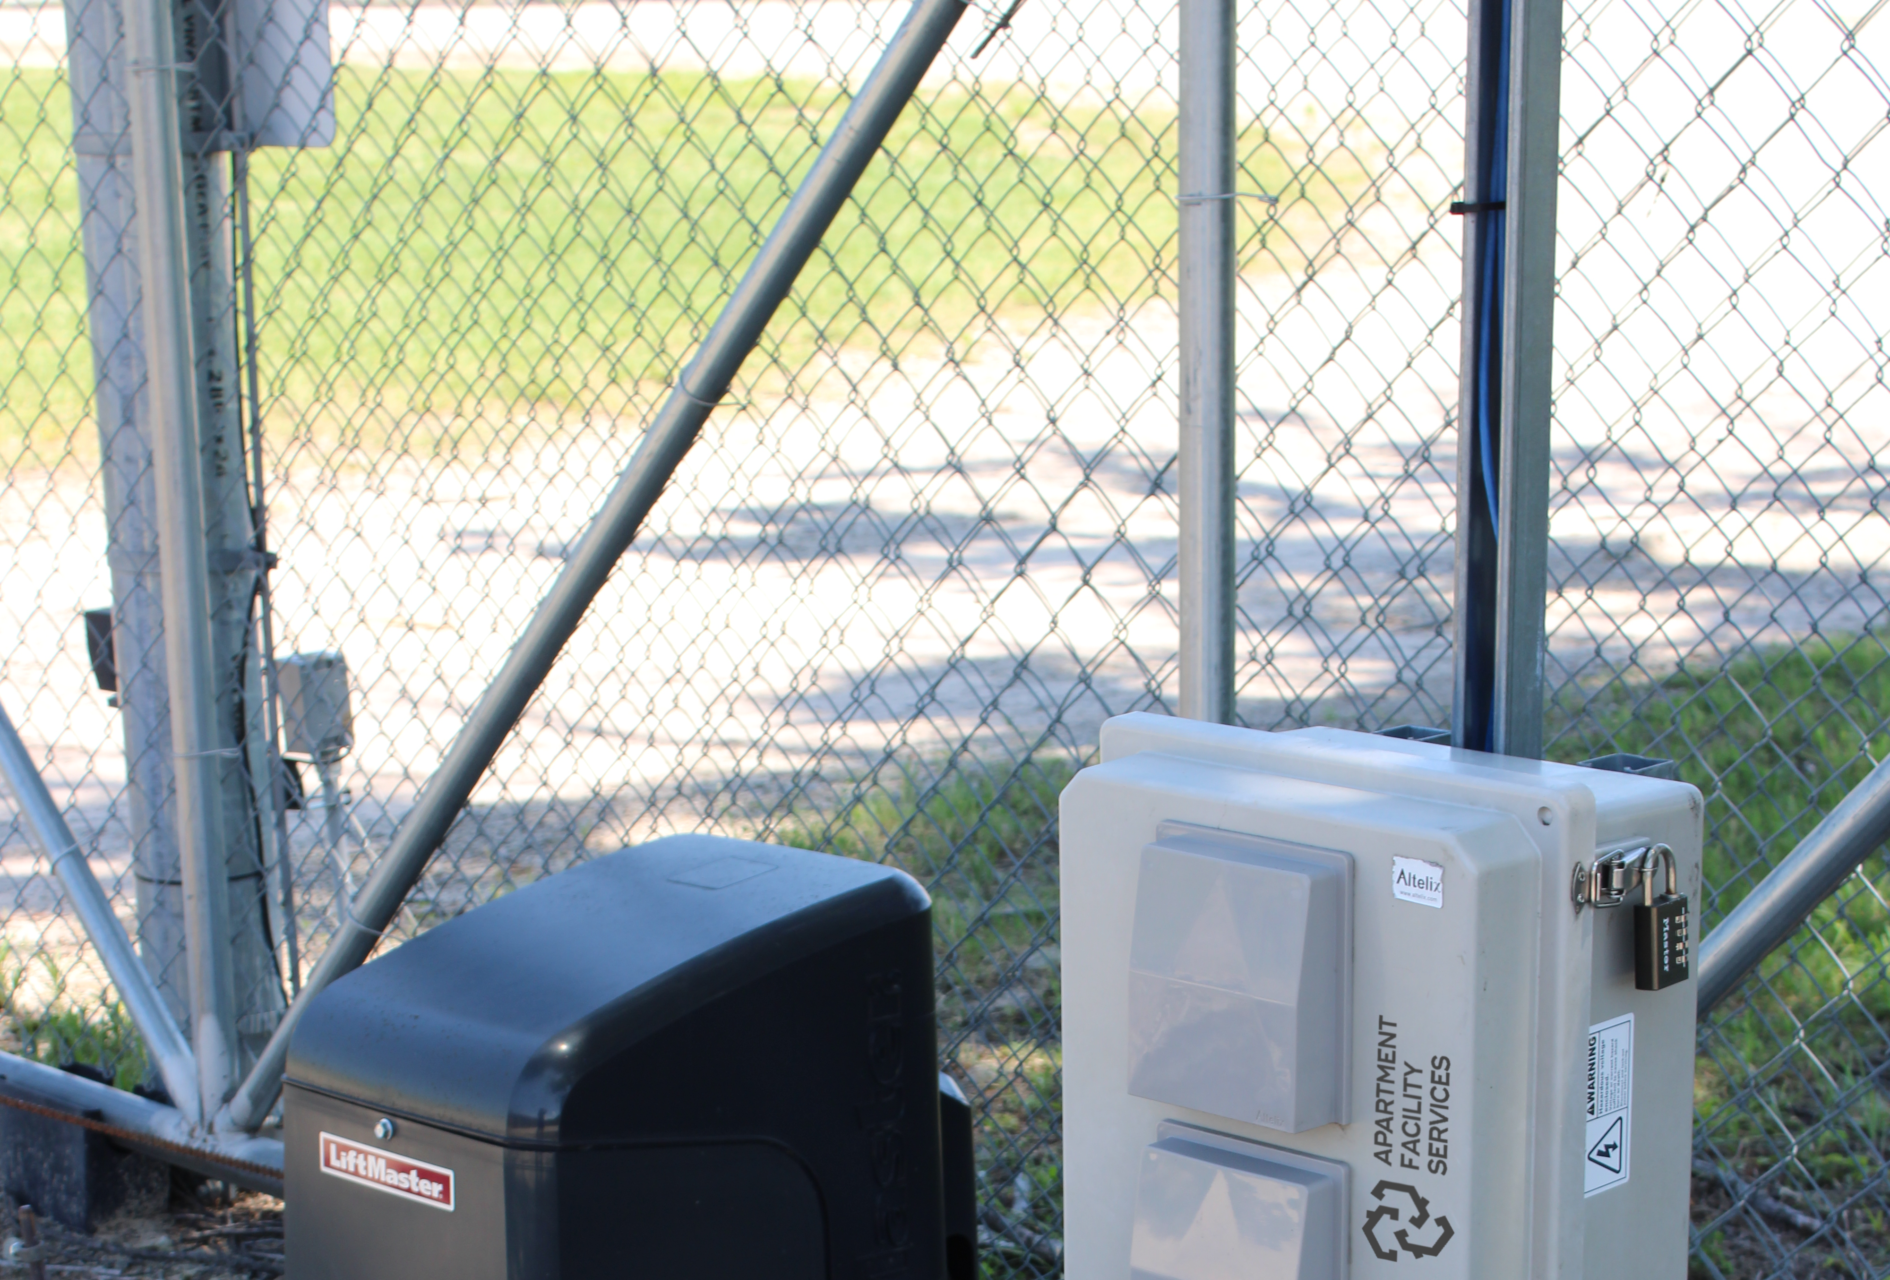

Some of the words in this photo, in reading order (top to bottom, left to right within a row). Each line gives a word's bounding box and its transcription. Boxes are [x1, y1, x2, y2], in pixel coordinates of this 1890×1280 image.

[1396, 868, 1442, 894] Altelix
[1662, 917, 1670, 972] Master
[1373, 1014, 1398, 1167] APARTMENT
[1587, 1036, 1597, 1104] WARNING
[1400, 1061, 1423, 1171] FACILITY
[1427, 1055, 1451, 1176] SERVICES
[329, 1142, 443, 1200] LiftMaster
